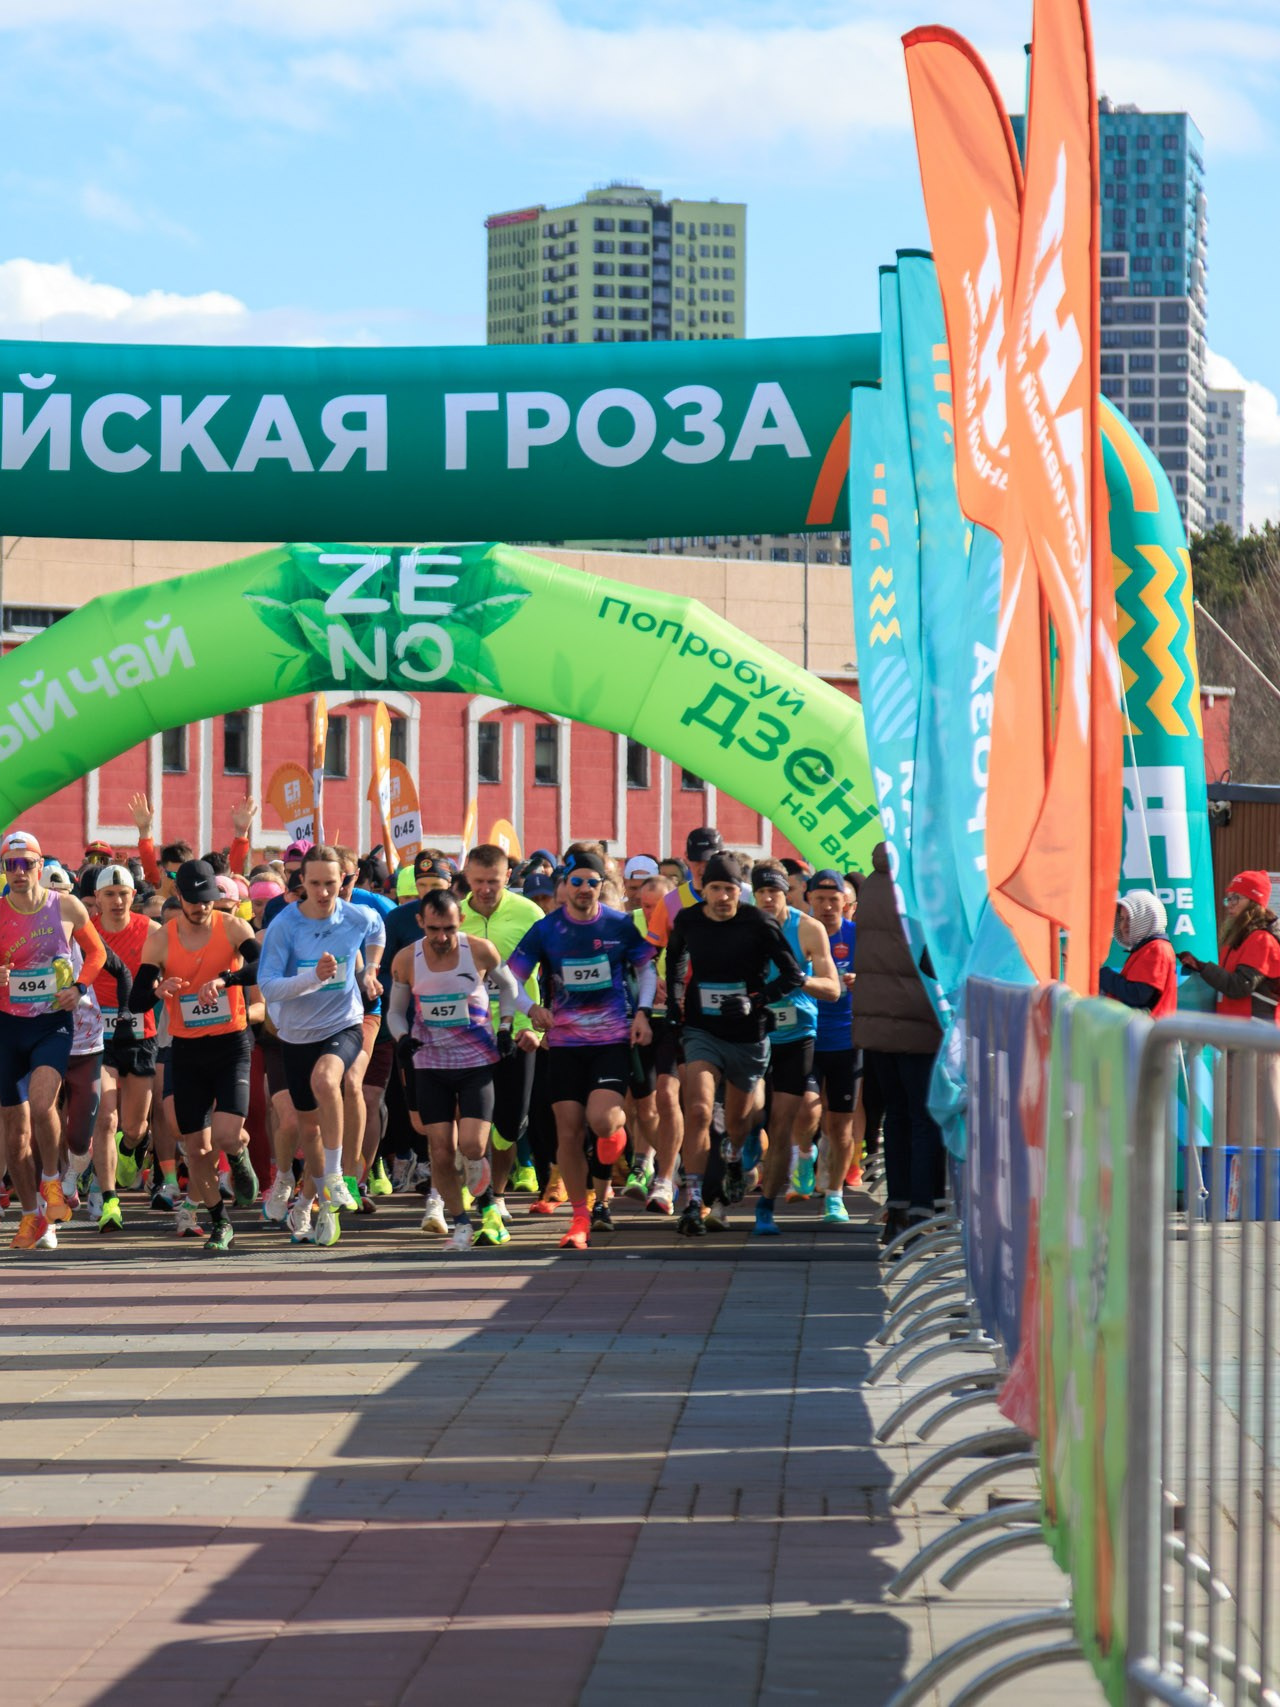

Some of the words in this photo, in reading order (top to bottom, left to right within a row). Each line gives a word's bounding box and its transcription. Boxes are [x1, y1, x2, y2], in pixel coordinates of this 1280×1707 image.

[444, 382, 811, 470] ГРОЗА
[598, 596, 806, 716] Попробуй
[680, 682, 880, 840] Дзен
[394, 820, 415, 838] 0:45
[780, 792, 819, 832] на
[820, 834, 866, 877] вк
[574, 968, 600, 980] 974
[18, 980, 47, 992] 494
[192, 1002, 219, 1016] 485
[431, 1005, 456, 1017] 457
[105, 1017, 138, 1028] 106
